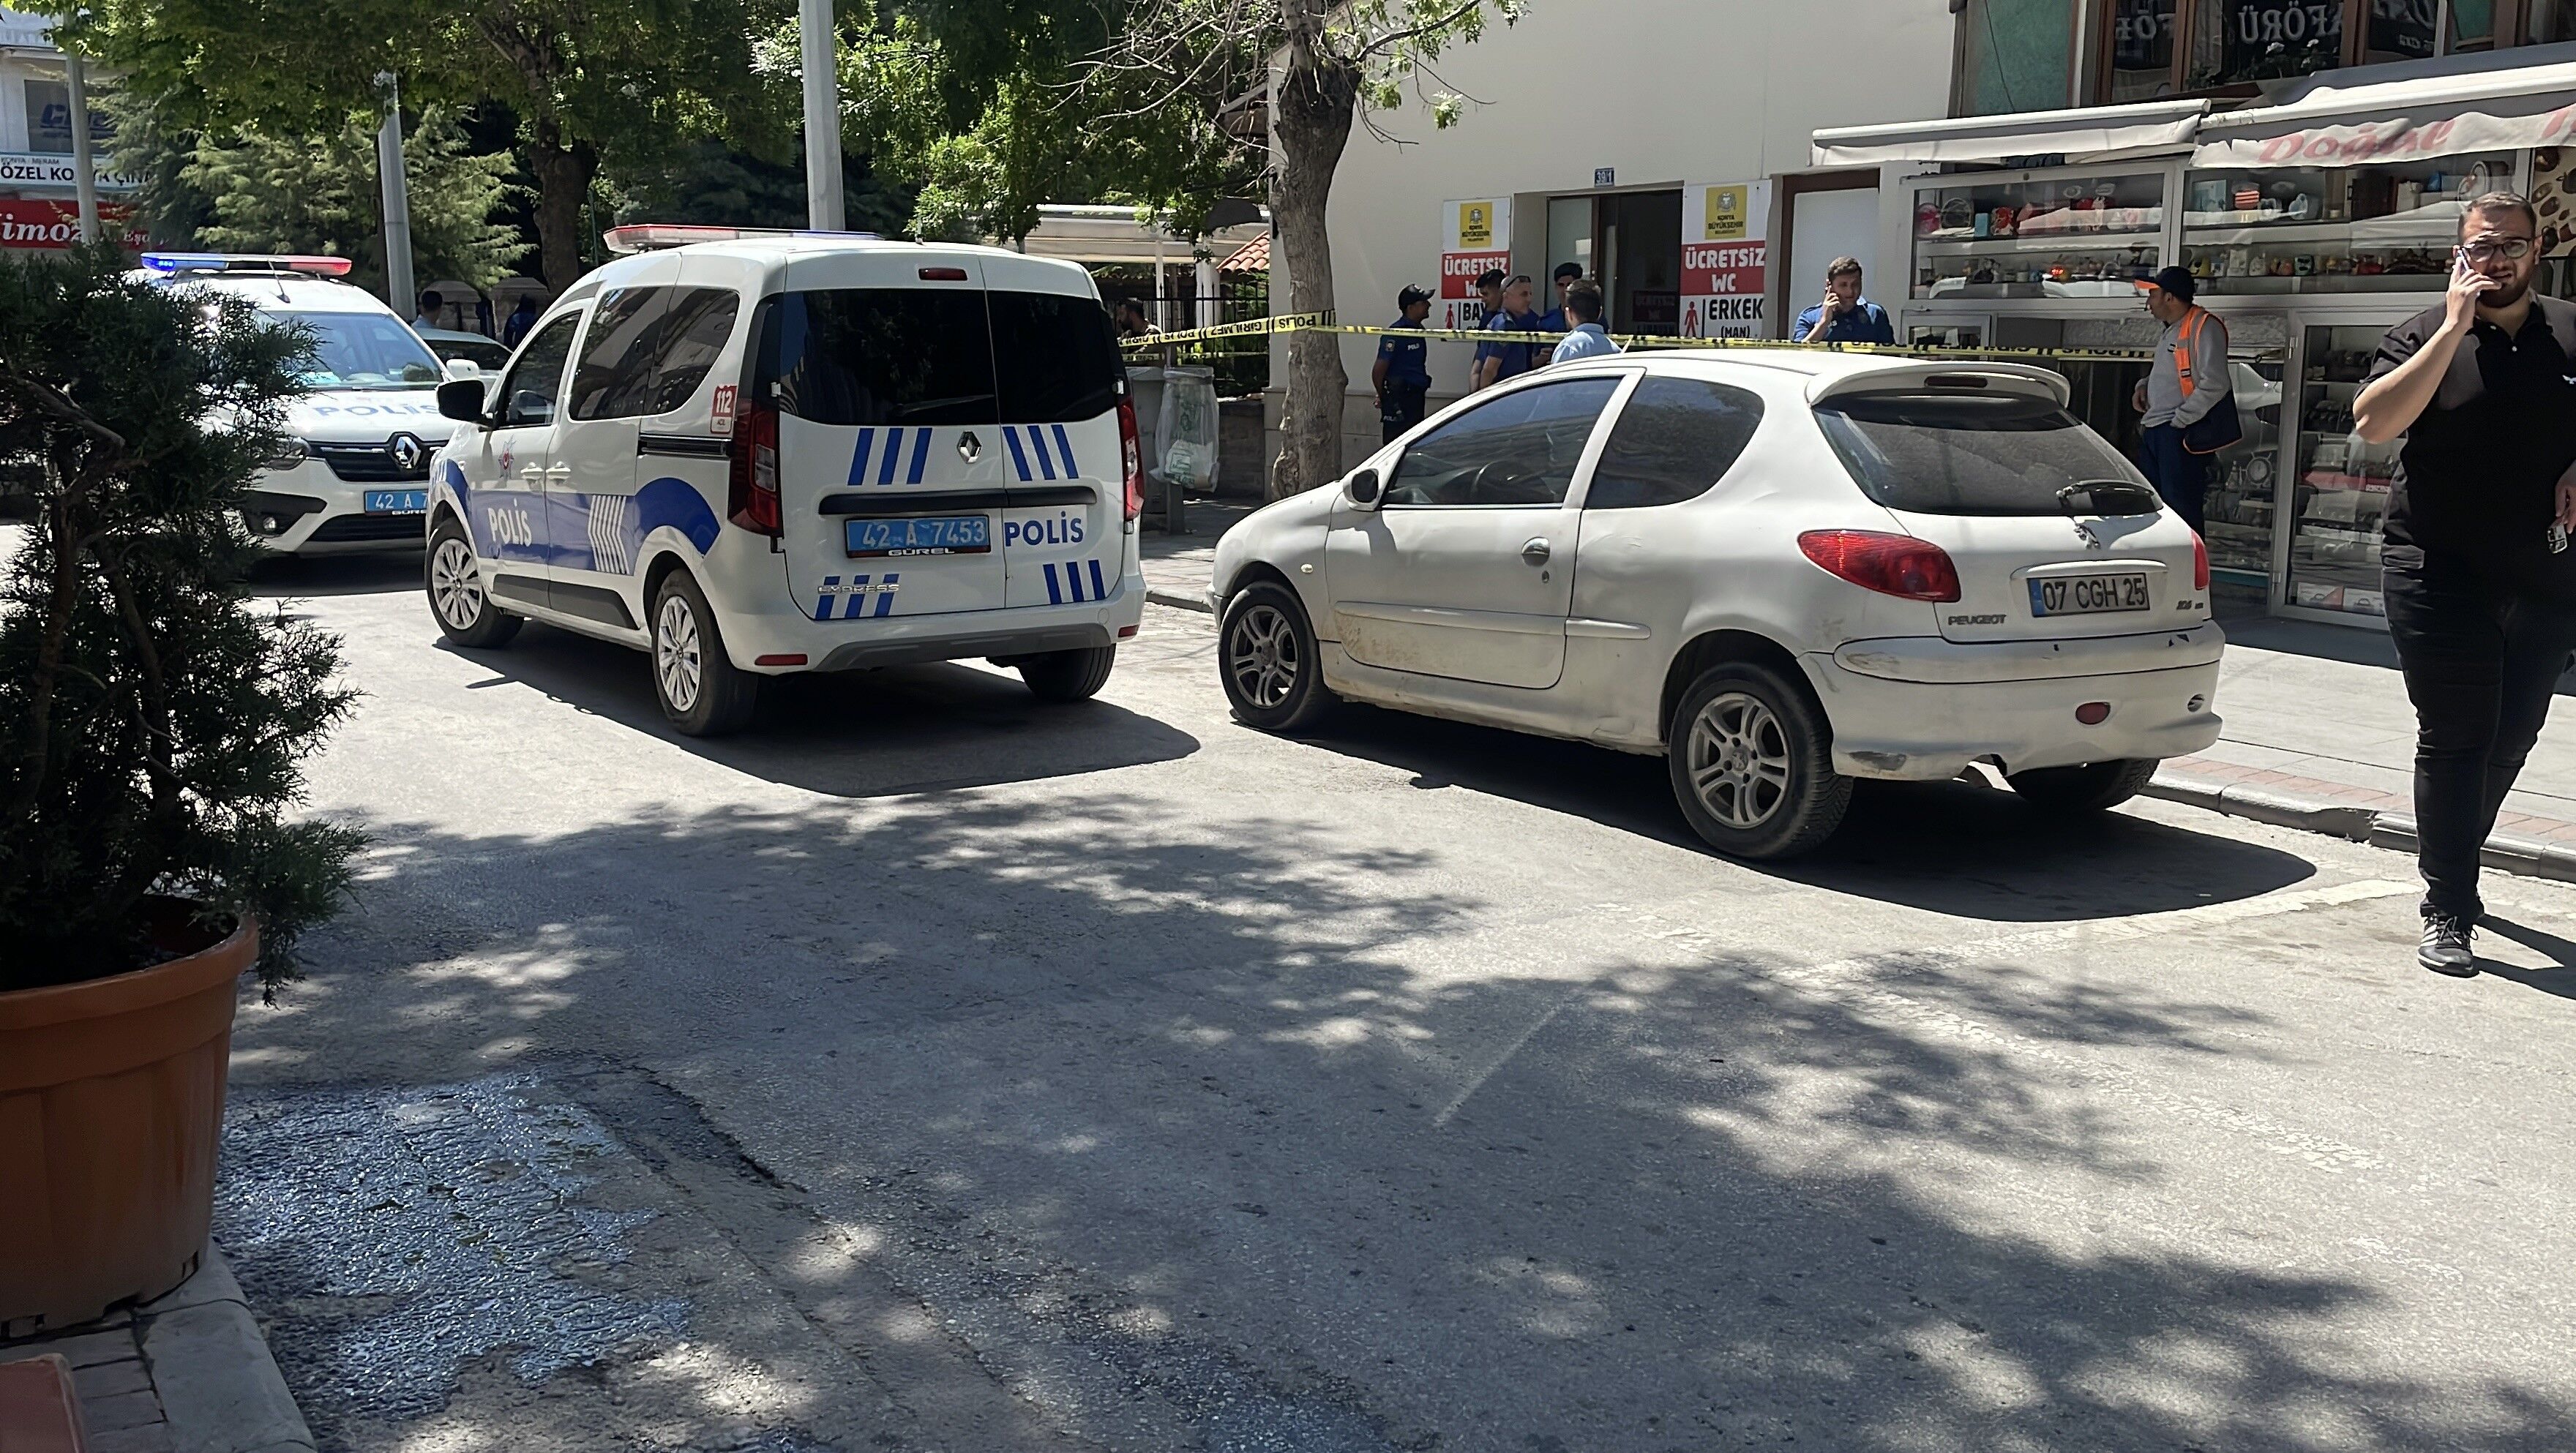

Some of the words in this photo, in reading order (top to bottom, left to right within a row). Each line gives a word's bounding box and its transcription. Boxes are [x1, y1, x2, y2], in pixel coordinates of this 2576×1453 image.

[1, 162, 46, 180] ÖZEL
[1685, 247, 1767, 270] ÜCRETSİZ
[1712, 273, 1737, 293] WC
[1709, 298, 1764, 320] ERKEK
[1721, 326, 1751, 339] (MAN)
[313, 403, 440, 416] POLİS
[716, 390, 733, 413] 112
[375, 494, 394, 509] 42
[404, 493, 413, 508] A
[488, 499, 532, 547] POLİS
[862, 523, 891, 547] 42
[907, 521, 919, 545] A
[934, 519, 986, 544] 7453
[1005, 511, 1084, 547] POLİS
[888, 547, 955, 556] GÜREL
[2042, 582, 2067, 610] 07
[2076, 577, 2119, 609] CGH
[2125, 574, 2146, 607] 25
[1948, 614, 2007, 626] PEUGEOT
